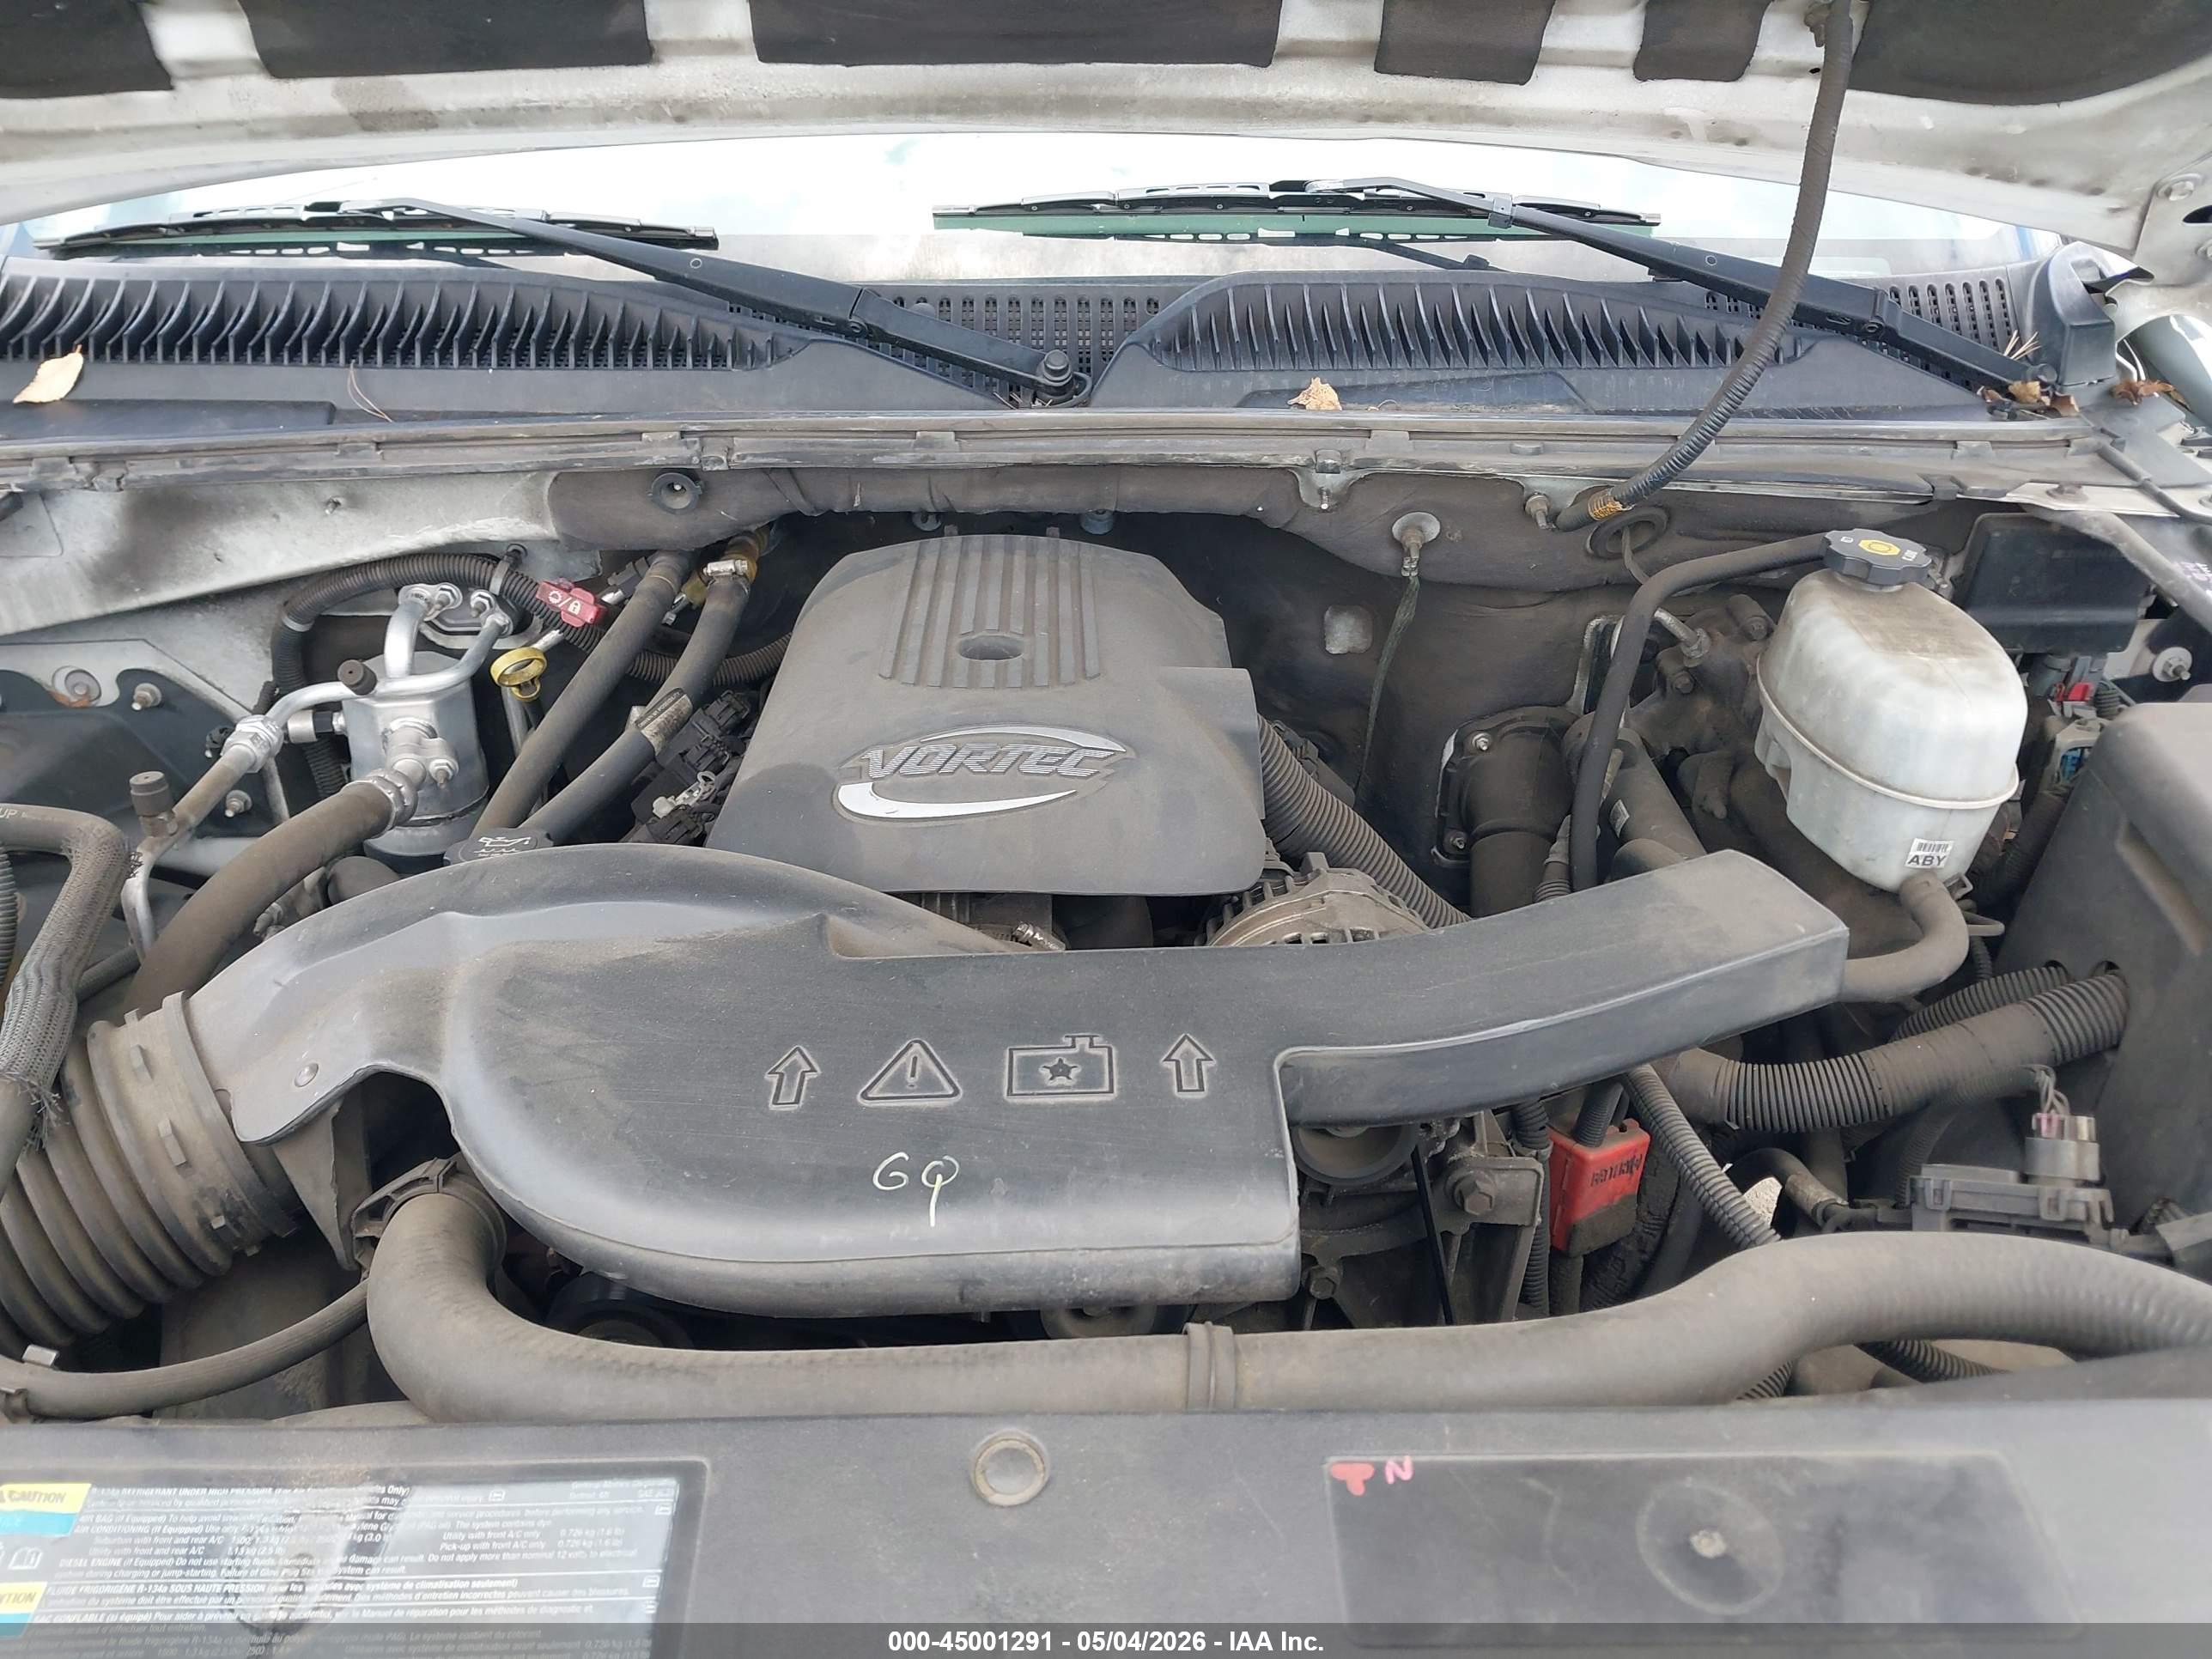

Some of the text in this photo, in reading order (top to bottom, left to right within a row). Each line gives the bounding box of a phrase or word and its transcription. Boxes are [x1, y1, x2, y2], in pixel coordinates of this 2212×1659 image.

[861, 743, 1116, 778] VORTEC
[1907, 854, 1947, 866] ABY
[179, 1487, 208, 1496] UNDER
[208, 1487, 229, 1496] HIGH
[387, 1485, 410, 1496] Only)
[8, 1490, 66, 1504] CAUTION
[381, 1497, 400, 1505] may
[94, 1514, 112, 1522] BAG
[125, 1513, 166, 1524] Equipped)
[168, 1514, 178, 1522] To
[179, 1513, 196, 1523] help
[198, 1513, 221, 1522] avoid
[374, 1510, 386, 1520] for
[90, 1524, 150, 1534] CONDITIONING
[162, 1524, 204, 1534] Equipped)
[204, 1524, 219, 1533] Use
[134, 1535, 152, 1544] with
[153, 1534, 173, 1544] front
[173, 1534, 189, 1544] and
[209, 1534, 224, 1543] A/C
[487, 1530, 506, 1540] front
[523, 1530, 541, 1540] only
[134, 1546, 153, 1555] front
[155, 1546, 171, 1555] and
[189, 1546, 205, 1554] A/C
[440, 1542, 471, 1552] Pick-up
[472, 1542, 491, 1551] with
[493, 1540, 512, 1551] front
[512, 1541, 528, 1550] A/C
[528, 1540, 546, 1551] only
[90, 1558, 122, 1567] ENGINE
[123, 1558, 132, 1567] (If
[133, 1557, 174, 1568] Equipped)
[175, 1558, 185, 1566] Do
[187, 1557, 202, 1566] not
[203, 1558, 219, 1566] use
[221, 1556, 251, 1567] starting
[428, 1552, 441, 1561] Do
[441, 1553, 455, 1561] not
[456, 1552, 477, 1563] apply
[479, 1552, 501, 1560] more
[502, 1551, 522, 1560] than
[556, 1550, 568, 1559] 12
[86, 1570, 112, 1579] during
[114, 1569, 149, 1579] charging
[161, 1567, 217, 1579] jump-starting.
[220, 1567, 247, 1577] Failure
[249, 1567, 258, 1577] of
[380, 1565, 407, 1574] result.
[137, 1583, 167, 1594] R-134a
[168, 1583, 192, 1593] SOUS
[193, 1583, 222, 1592] HAUTE
[222, 1583, 266, 1593] PRESSION
[289, 1583, 304, 1593] les
[343, 1582, 365, 1591] avec
[367, 1580, 401, 1592] système
[402, 1581, 414, 1589] de
[415, 1578, 469, 1590] climatisation
[471, 1578, 519, 1589] seulement)
[100, 1595, 137, 1607] système
[137, 1595, 154, 1604] doit
[155, 1594, 173, 1604] être
[173, 1594, 208, 1604] effectué
[208, 1595, 223, 1605] par
[372, 1591, 412, 1601] méthodes
[414, 1590, 459, 1601] d'entretien
[459, 1589, 506, 1600] incorrectes
[52, 1612, 105, 1622] GONFLABLE
[118, 1611, 152, 1622] équipé)
[153, 1611, 173, 1621] Pour
[173, 1611, 196, 1621] aider
[361, 1608, 392, 1617] Manuel
[393, 1608, 404, 1617] de
[406, 1607, 447, 1618] réparation
[448, 1607, 470, 1617] pour
[471, 1606, 483, 1615] les
[484, 1605, 526, 1615] méthodes
